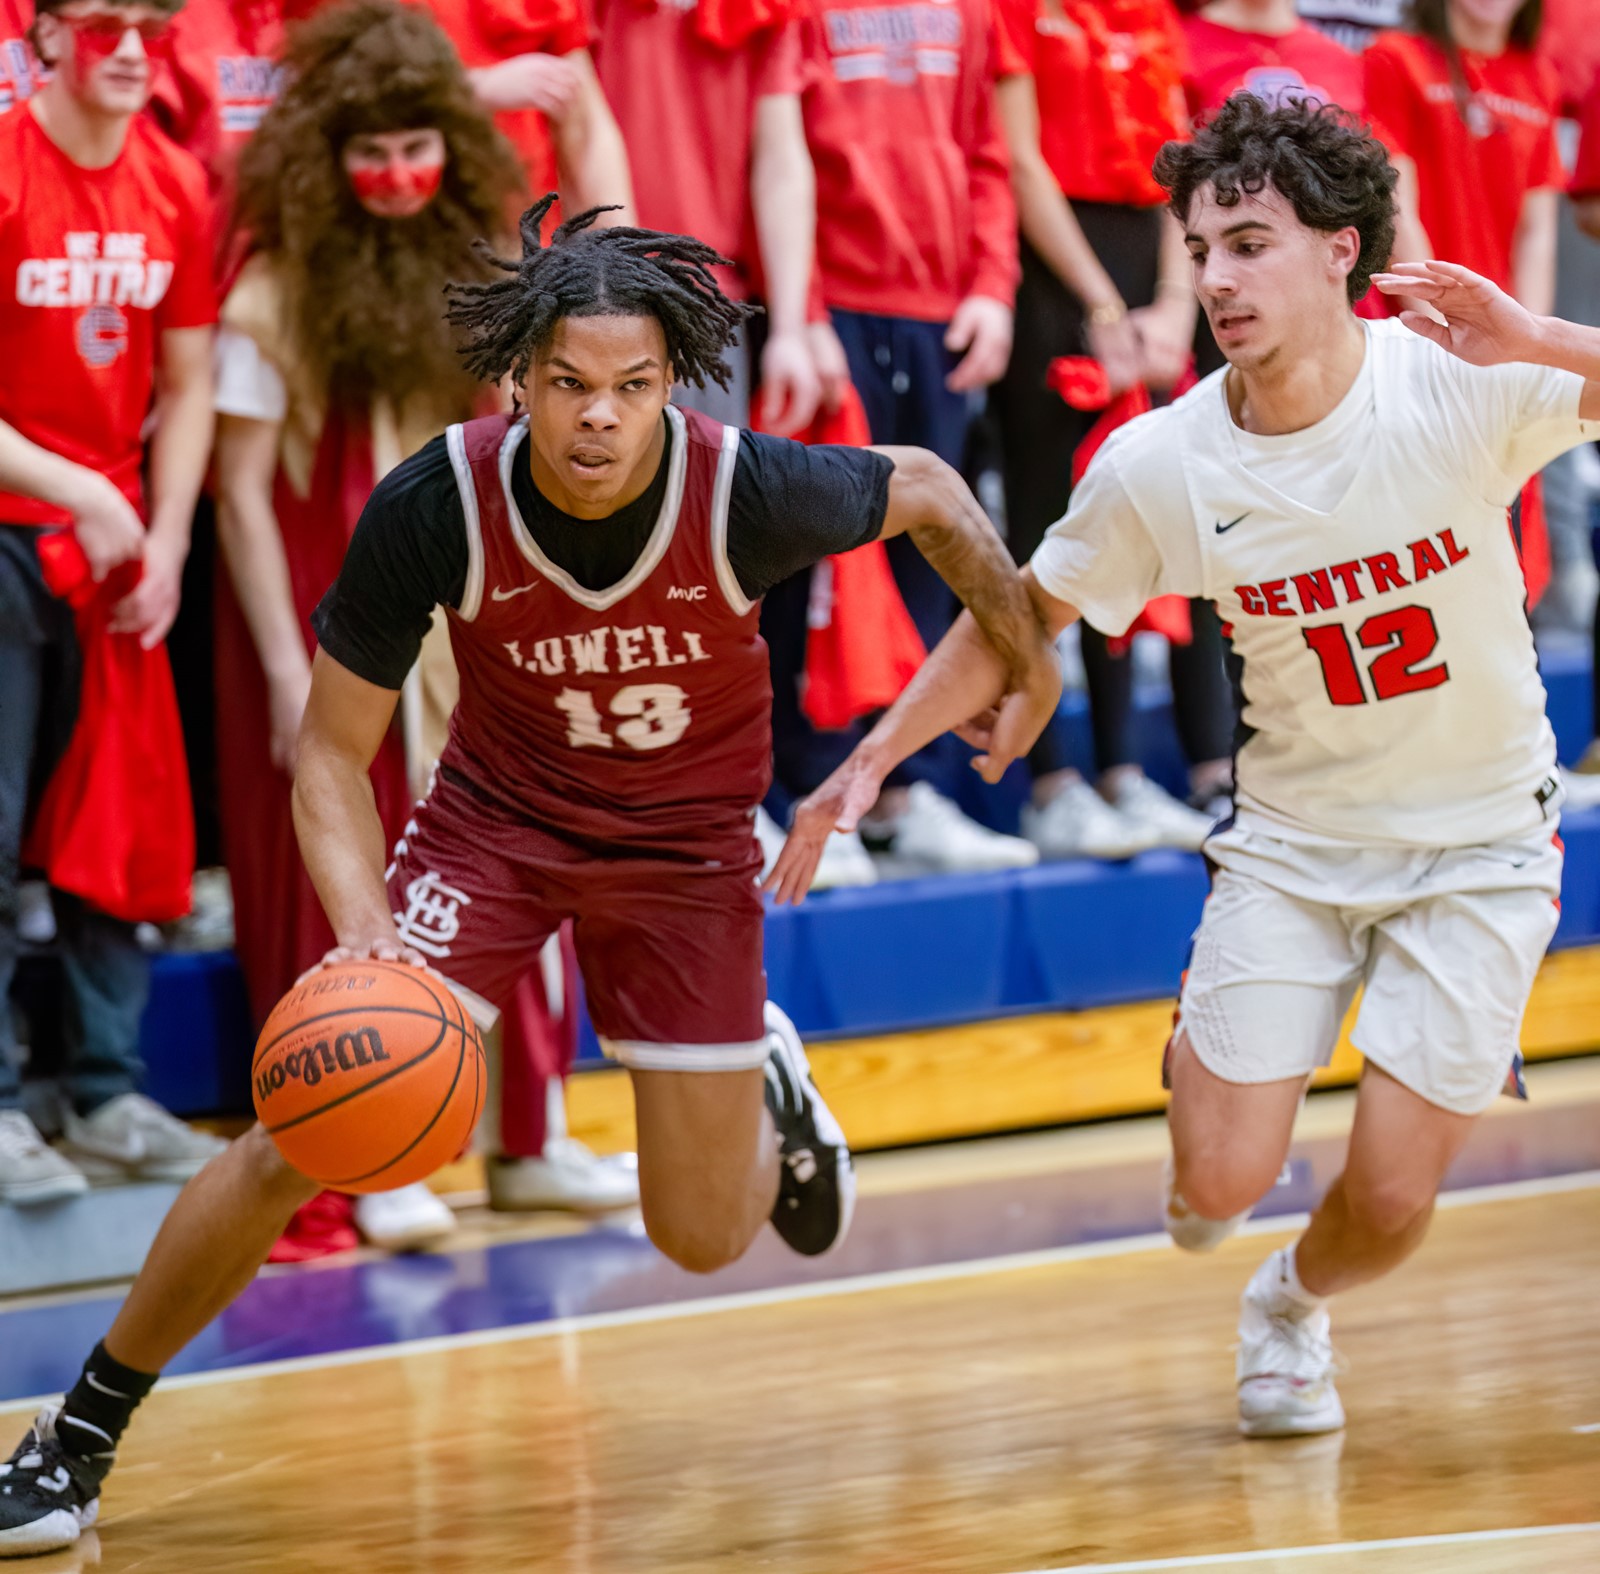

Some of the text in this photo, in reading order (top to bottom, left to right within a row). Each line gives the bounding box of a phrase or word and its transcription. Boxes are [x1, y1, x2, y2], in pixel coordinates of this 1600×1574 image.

[667, 585, 707, 601] MVC
[1233, 527, 1470, 616] CENTRAL
[502, 624, 712, 676] LOWELL
[1301, 603, 1449, 706] 12
[554, 683, 692, 751] 13
[255, 1025, 391, 1102] Wilson
